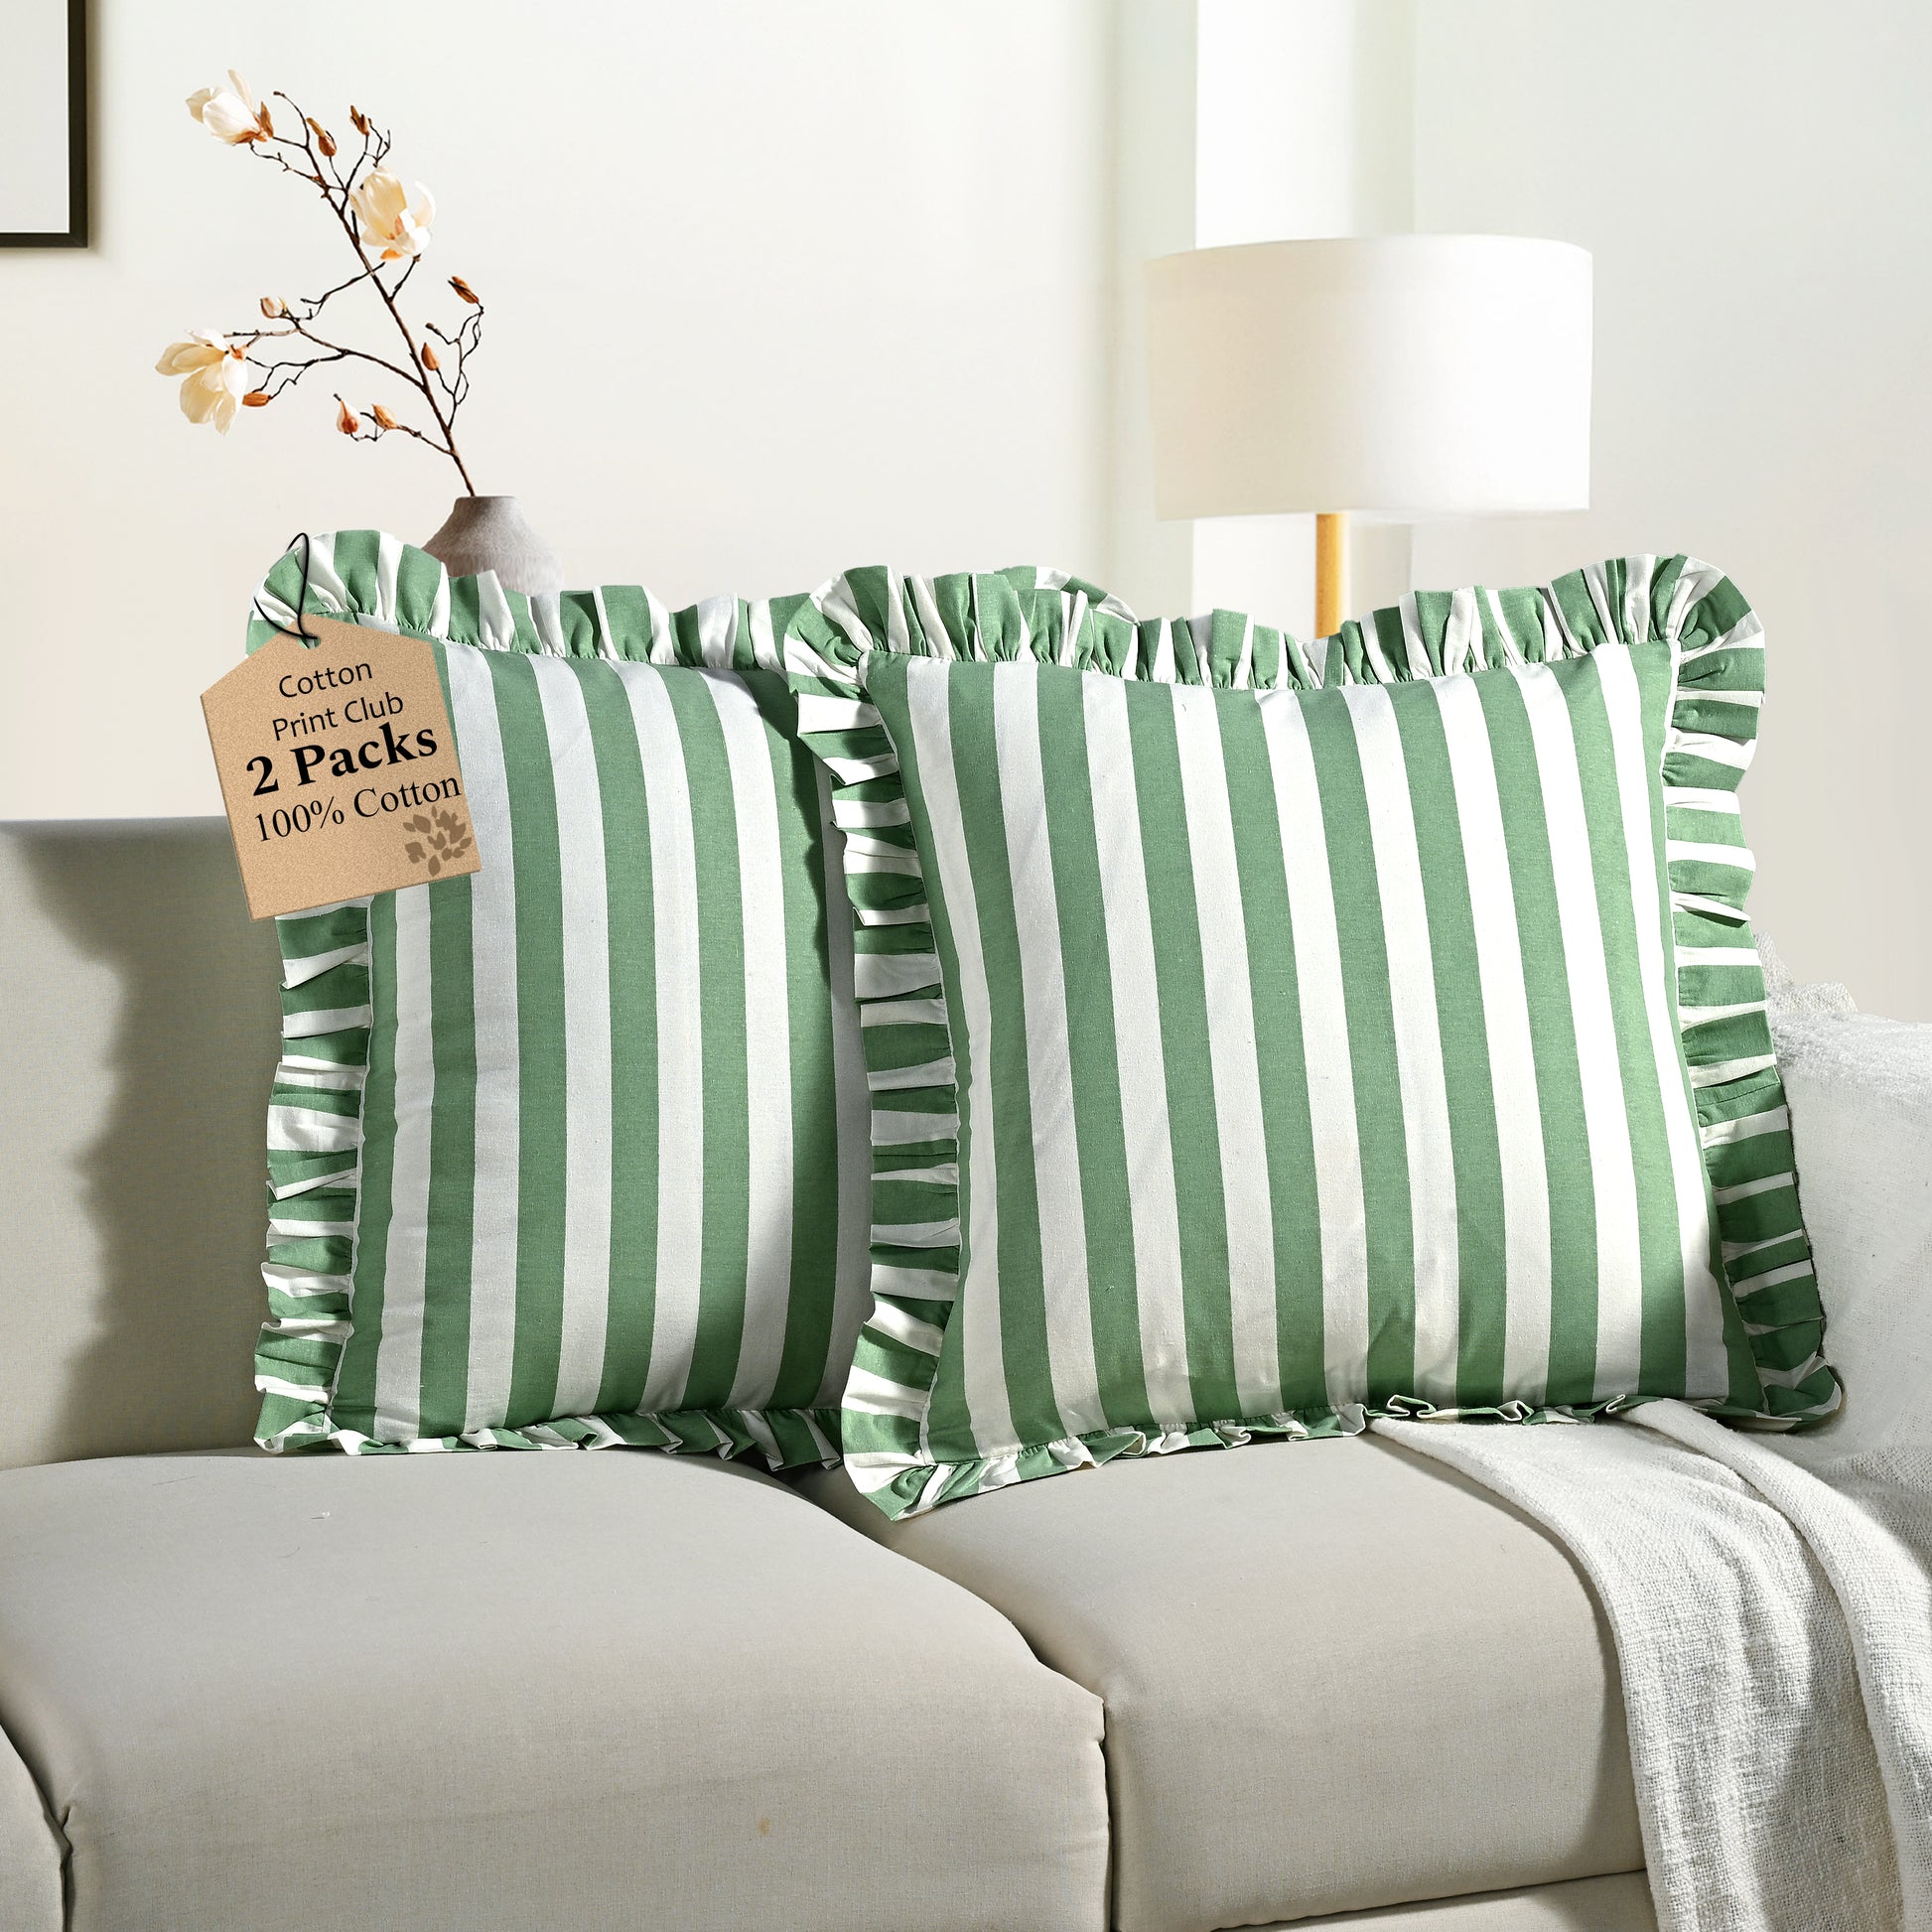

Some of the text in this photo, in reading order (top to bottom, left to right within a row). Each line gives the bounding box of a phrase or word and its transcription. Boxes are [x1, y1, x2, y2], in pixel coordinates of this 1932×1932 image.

[278, 662, 373, 698] Cotton
[272, 691, 404, 742] Print Club
[246, 721, 438, 797] 2 Packs
[254, 777, 462, 843] 100% Cotton
